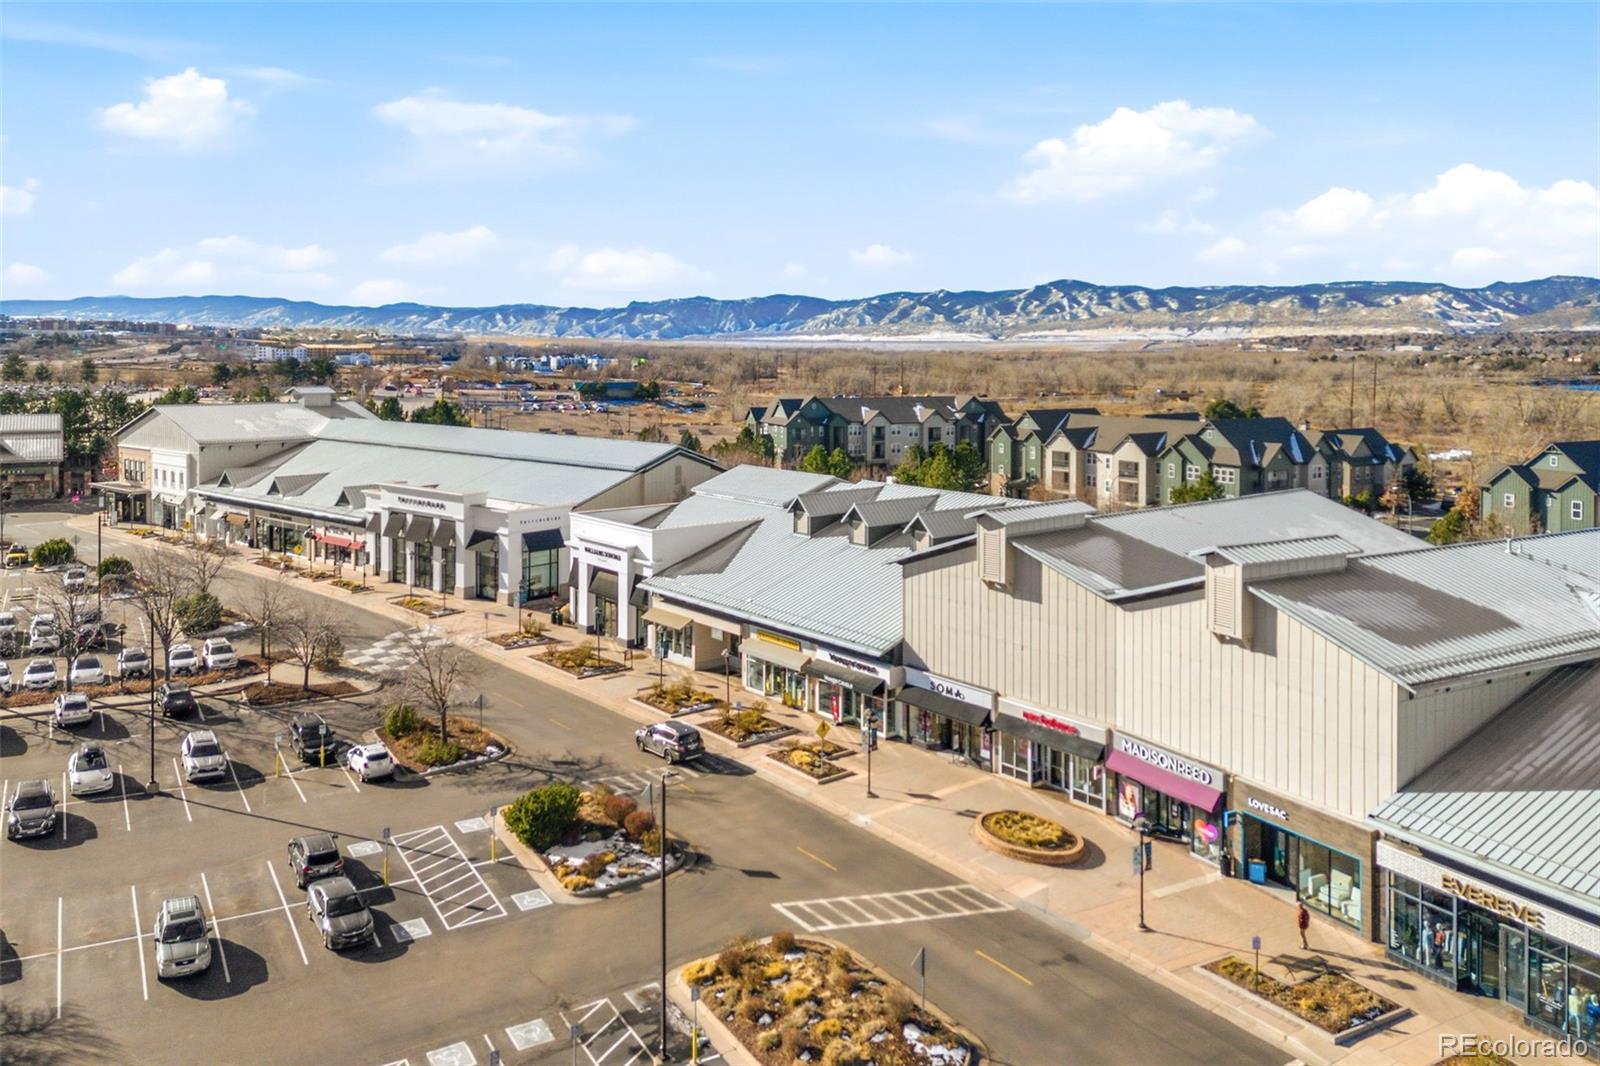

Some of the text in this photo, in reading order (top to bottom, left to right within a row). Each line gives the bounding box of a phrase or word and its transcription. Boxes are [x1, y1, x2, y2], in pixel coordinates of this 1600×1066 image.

[930, 680, 961, 698] SOMA
[1248, 797, 1287, 820] LOVESAC
[1441, 874, 1544, 929] EVEREVE
